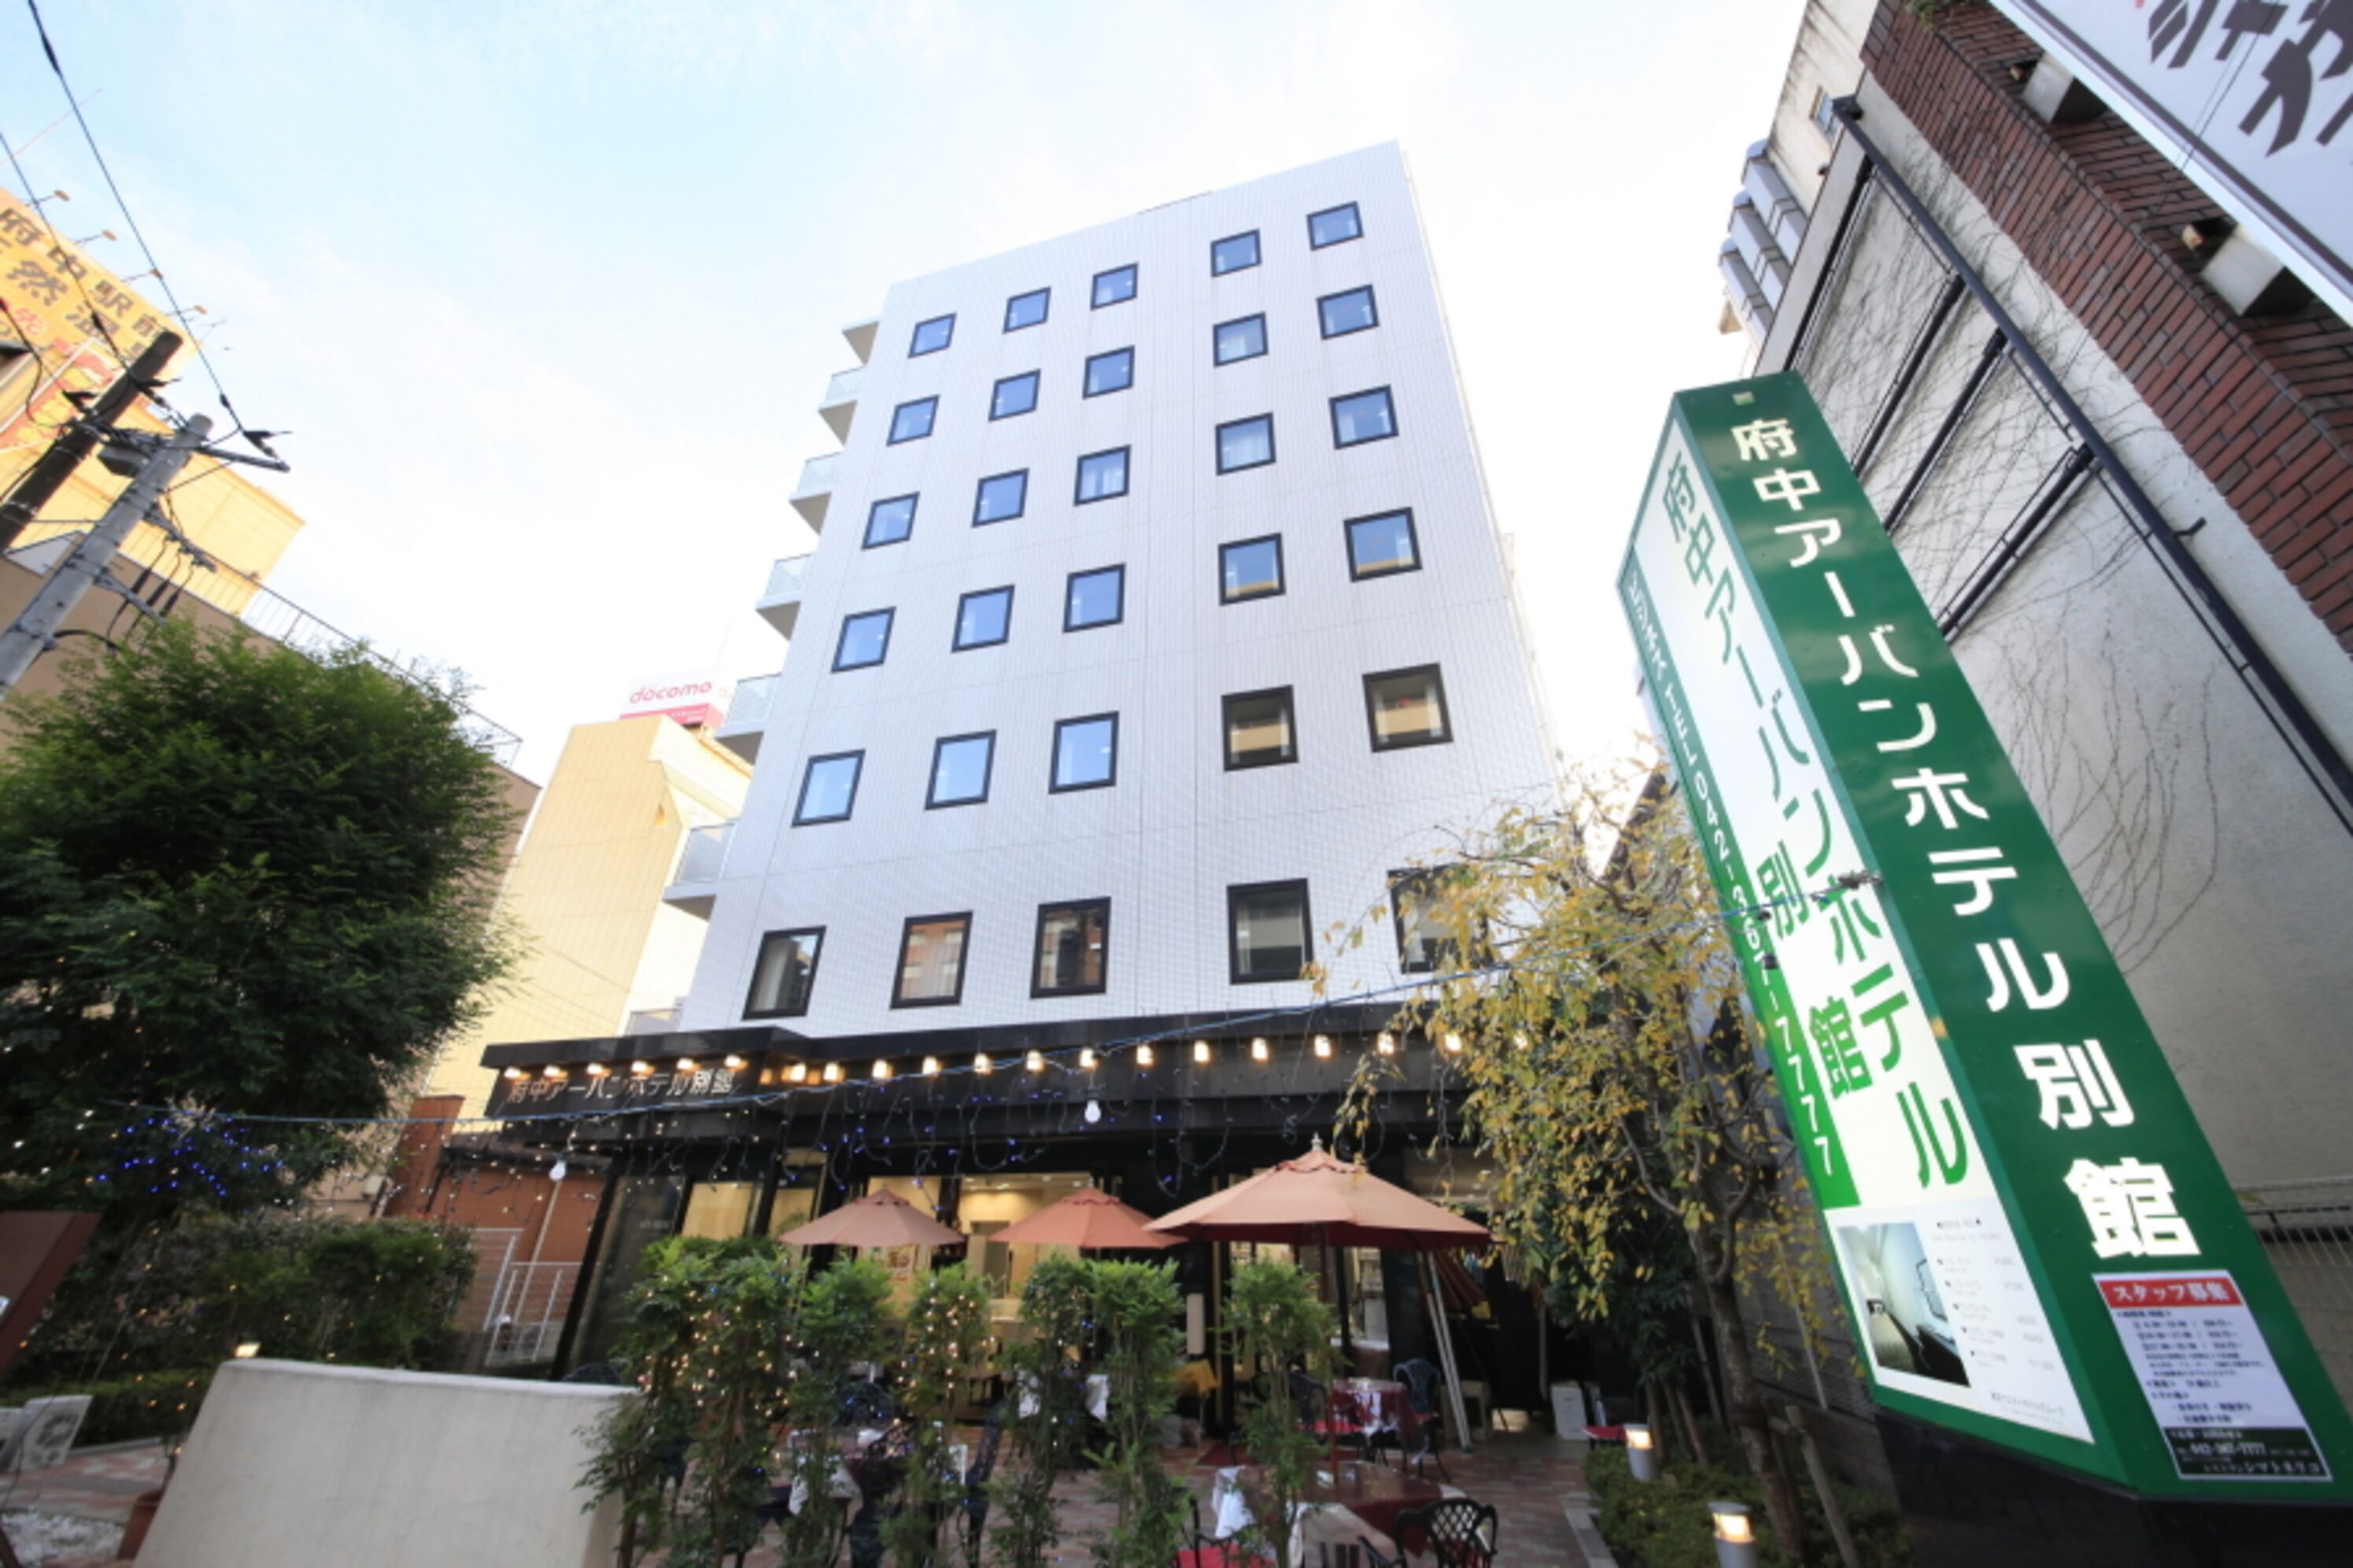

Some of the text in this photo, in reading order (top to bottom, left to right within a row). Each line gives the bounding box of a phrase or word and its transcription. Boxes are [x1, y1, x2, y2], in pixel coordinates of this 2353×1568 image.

[630, 681, 713, 703] docomo
[1662, 451, 1969, 1189] 府中アーバンホテル
[1731, 419, 2201, 1259] 府中アーバンホテル別館
[1756, 839, 1873, 1099] 別館
[2112, 1282, 2231, 1303] スタッフ募集
